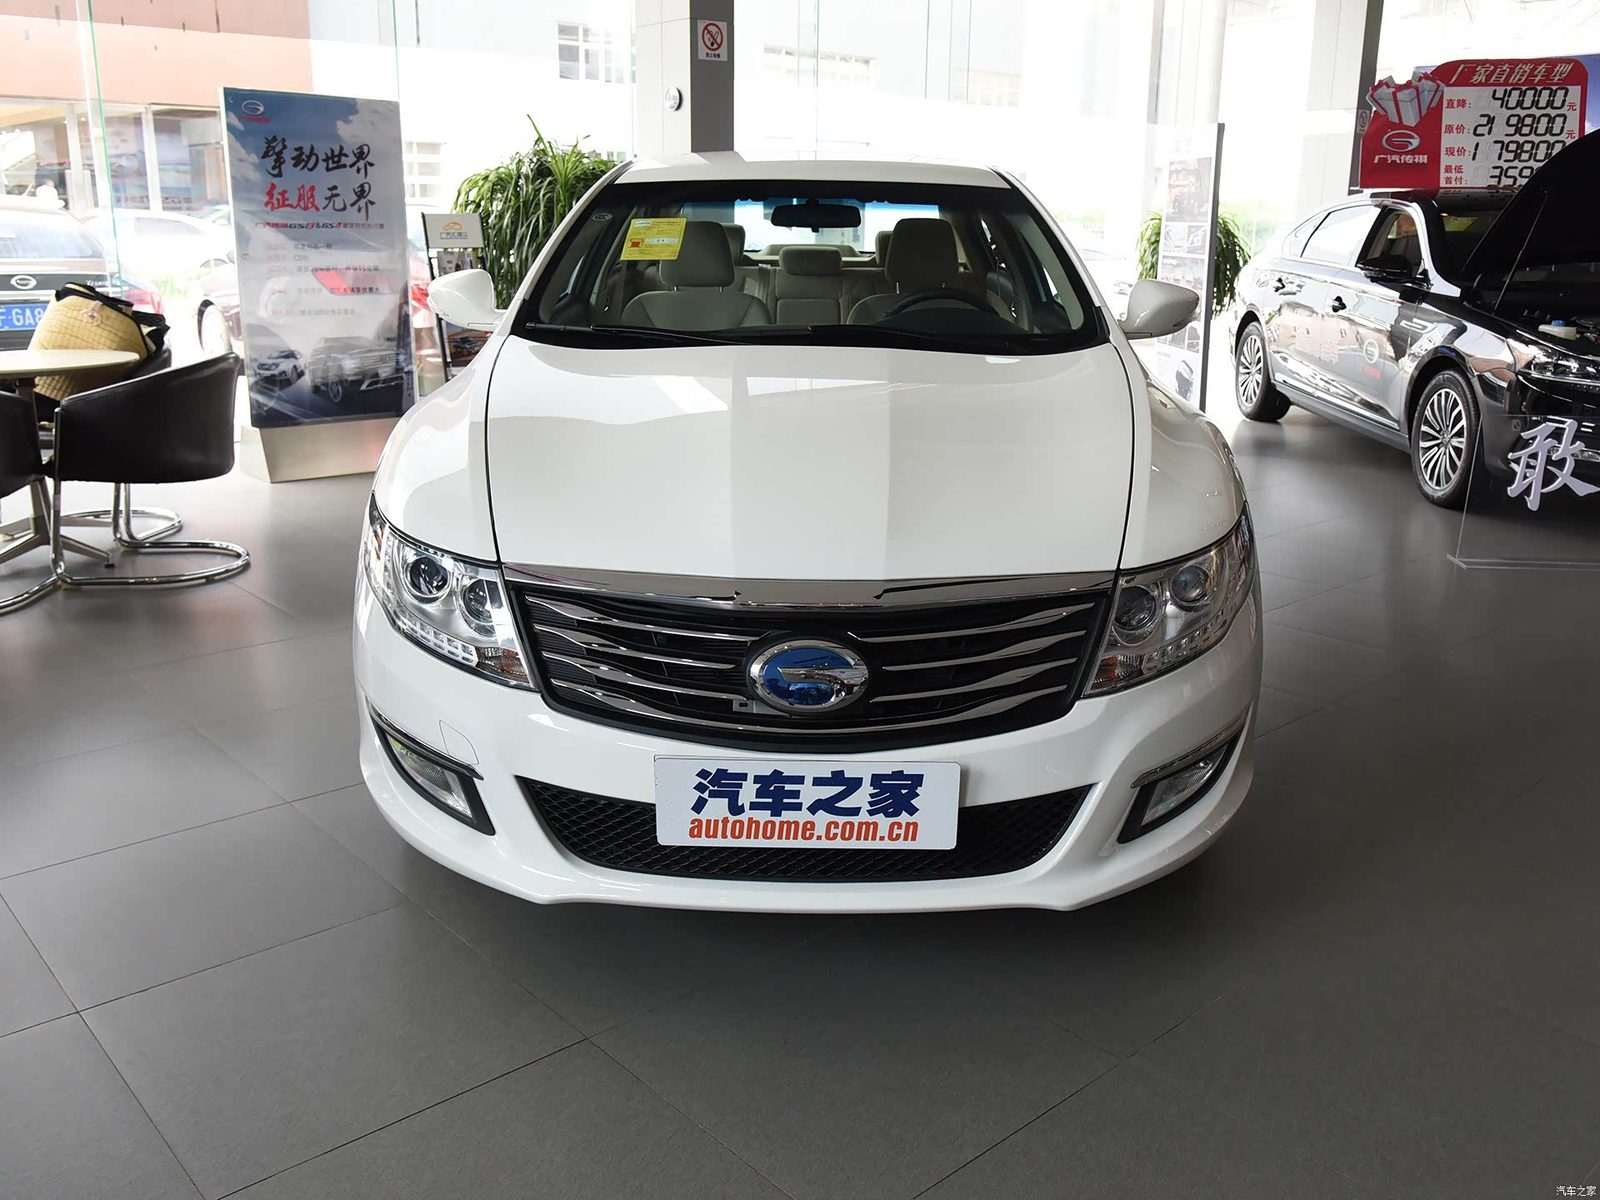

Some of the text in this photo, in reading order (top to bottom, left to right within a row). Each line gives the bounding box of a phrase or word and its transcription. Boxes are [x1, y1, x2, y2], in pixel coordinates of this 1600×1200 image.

[1450, 62, 1575, 84] 厂家直销车型
[1491, 87, 1570, 110] 40000
[1567, 102, 1577, 112] 元
[1565, 129, 1576, 140] 元
[261, 135, 376, 179] 擎动世界
[1443, 164, 1464, 174] 最低
[263, 181, 377, 222] 征服无界
[1507, 419, 1600, 511] 敢
[690, 767, 925, 818] 汽车之家
[688, 816, 920, 842] autohome.com.cn
